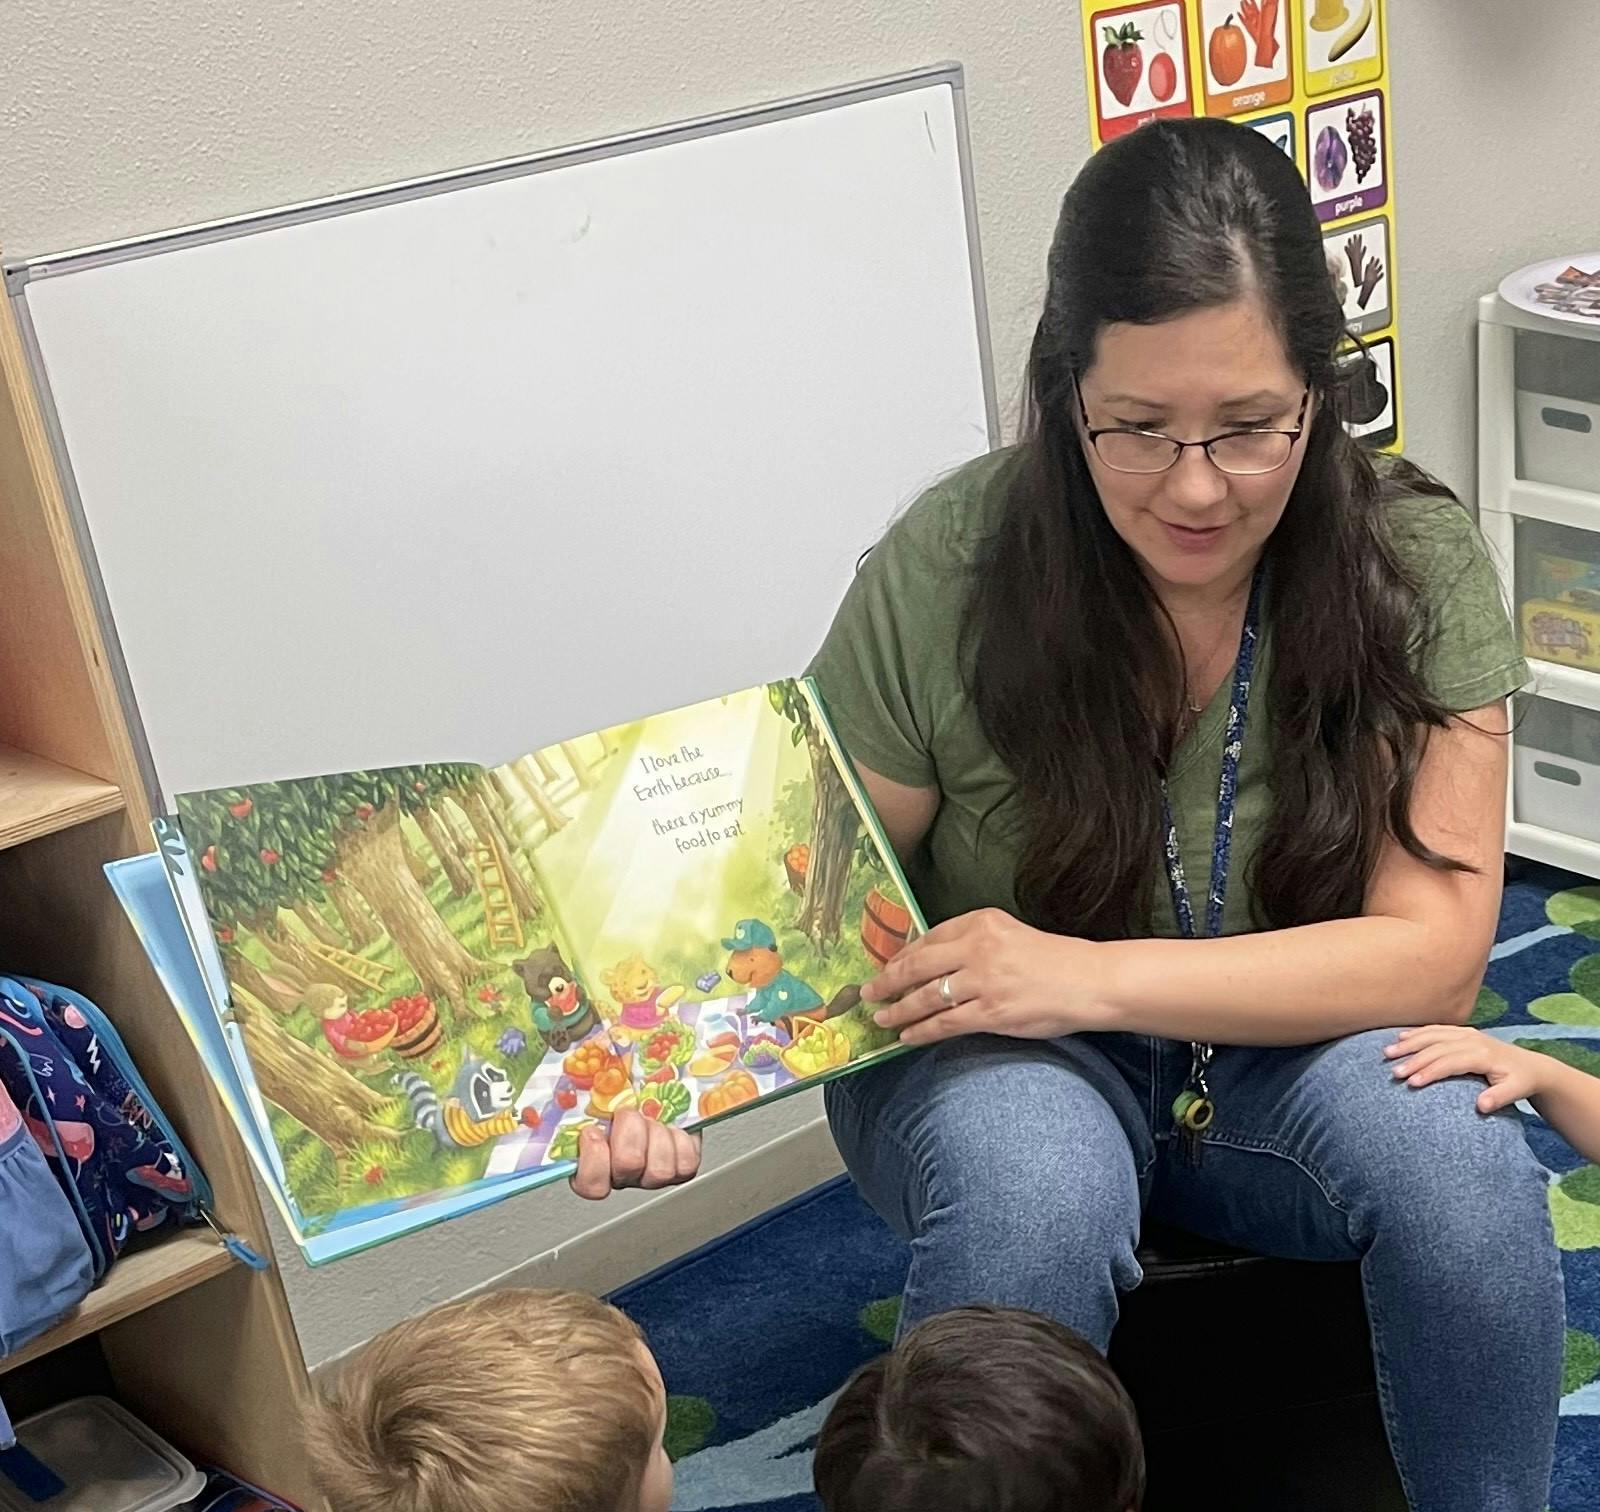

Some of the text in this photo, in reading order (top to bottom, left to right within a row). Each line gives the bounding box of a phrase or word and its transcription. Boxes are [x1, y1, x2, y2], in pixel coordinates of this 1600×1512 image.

[1232, 91, 1265, 107] orange
[1335, 195, 1362, 216] purple
[640, 745, 704, 774] I love the
[633, 777, 673, 802] Earth
[651, 816, 688, 836] there
[699, 798, 743, 824] yummy
[675, 831, 707, 853] food
[706, 828, 721, 846] to
